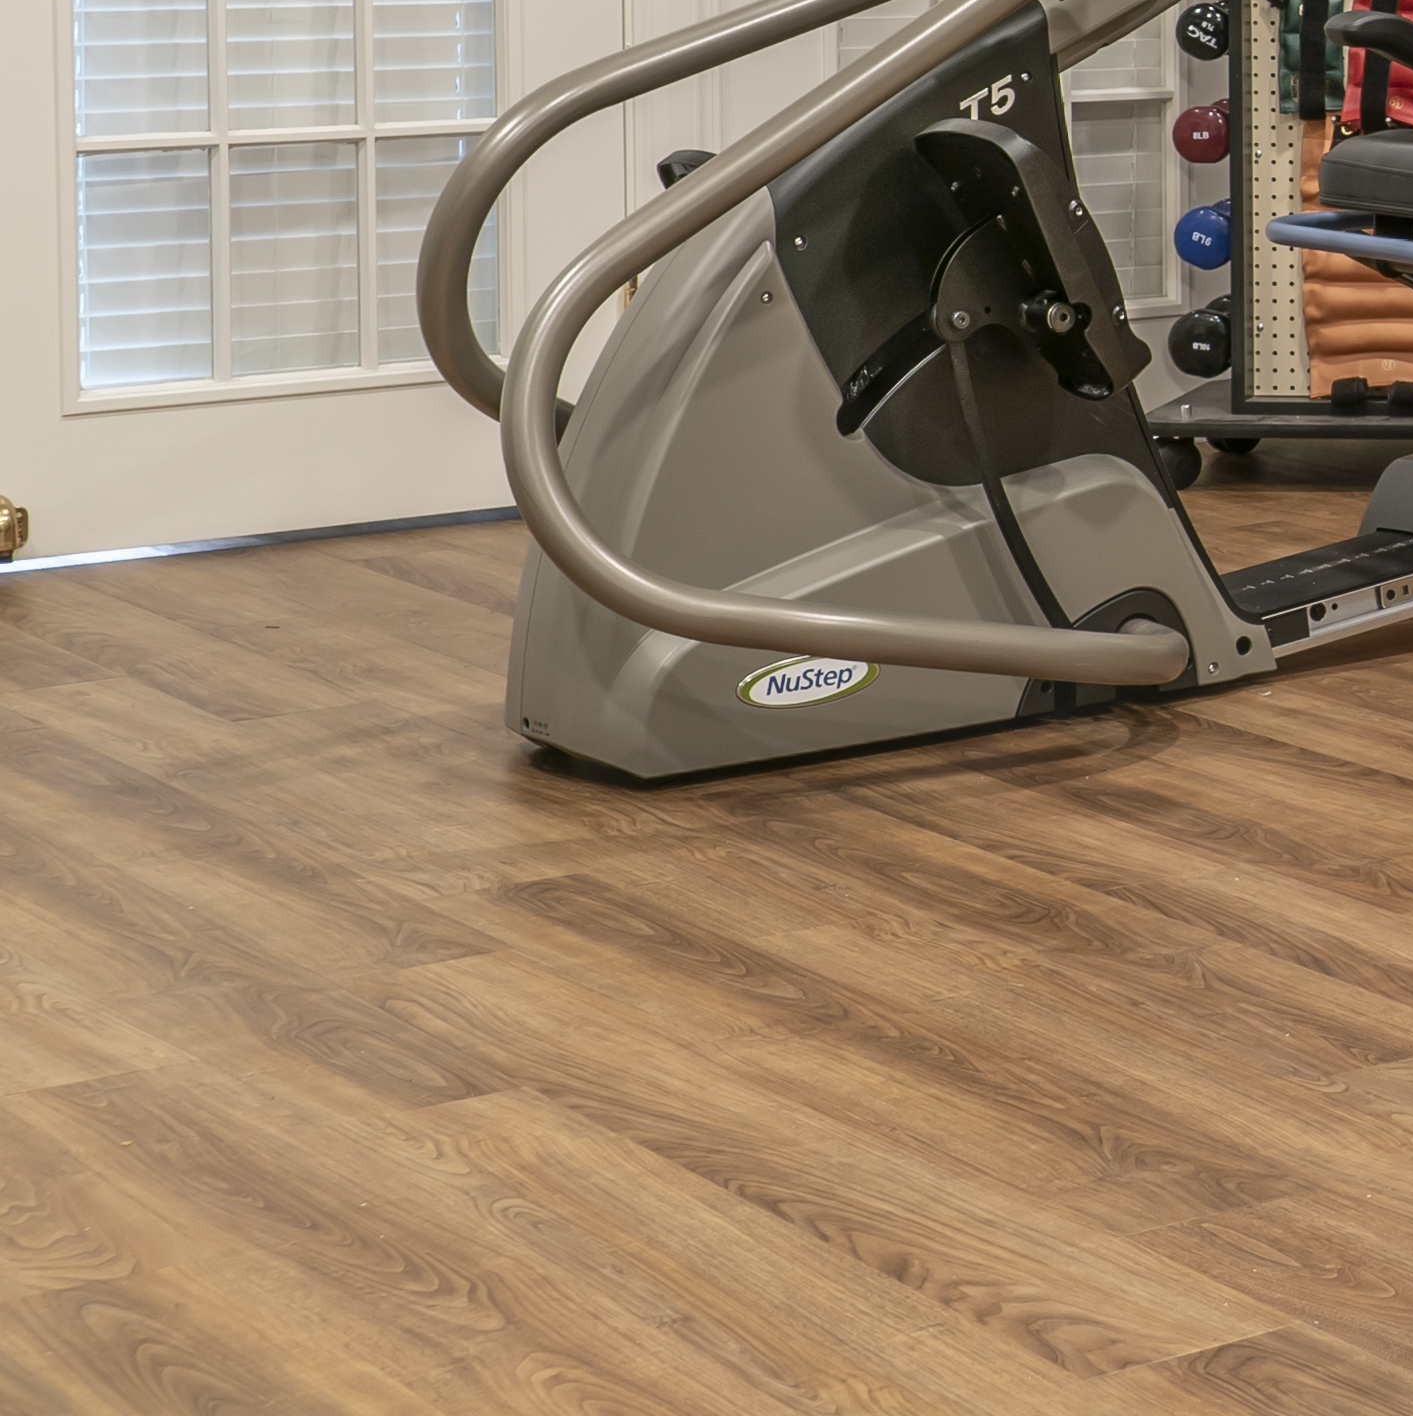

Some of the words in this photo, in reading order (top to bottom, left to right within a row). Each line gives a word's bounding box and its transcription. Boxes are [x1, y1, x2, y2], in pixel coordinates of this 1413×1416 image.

[1186, 24, 1218, 49] TAG
[959, 73, 1016, 121] T5
[1191, 231, 1212, 246] 9LB
[766, 667, 853, 696] NuStep
